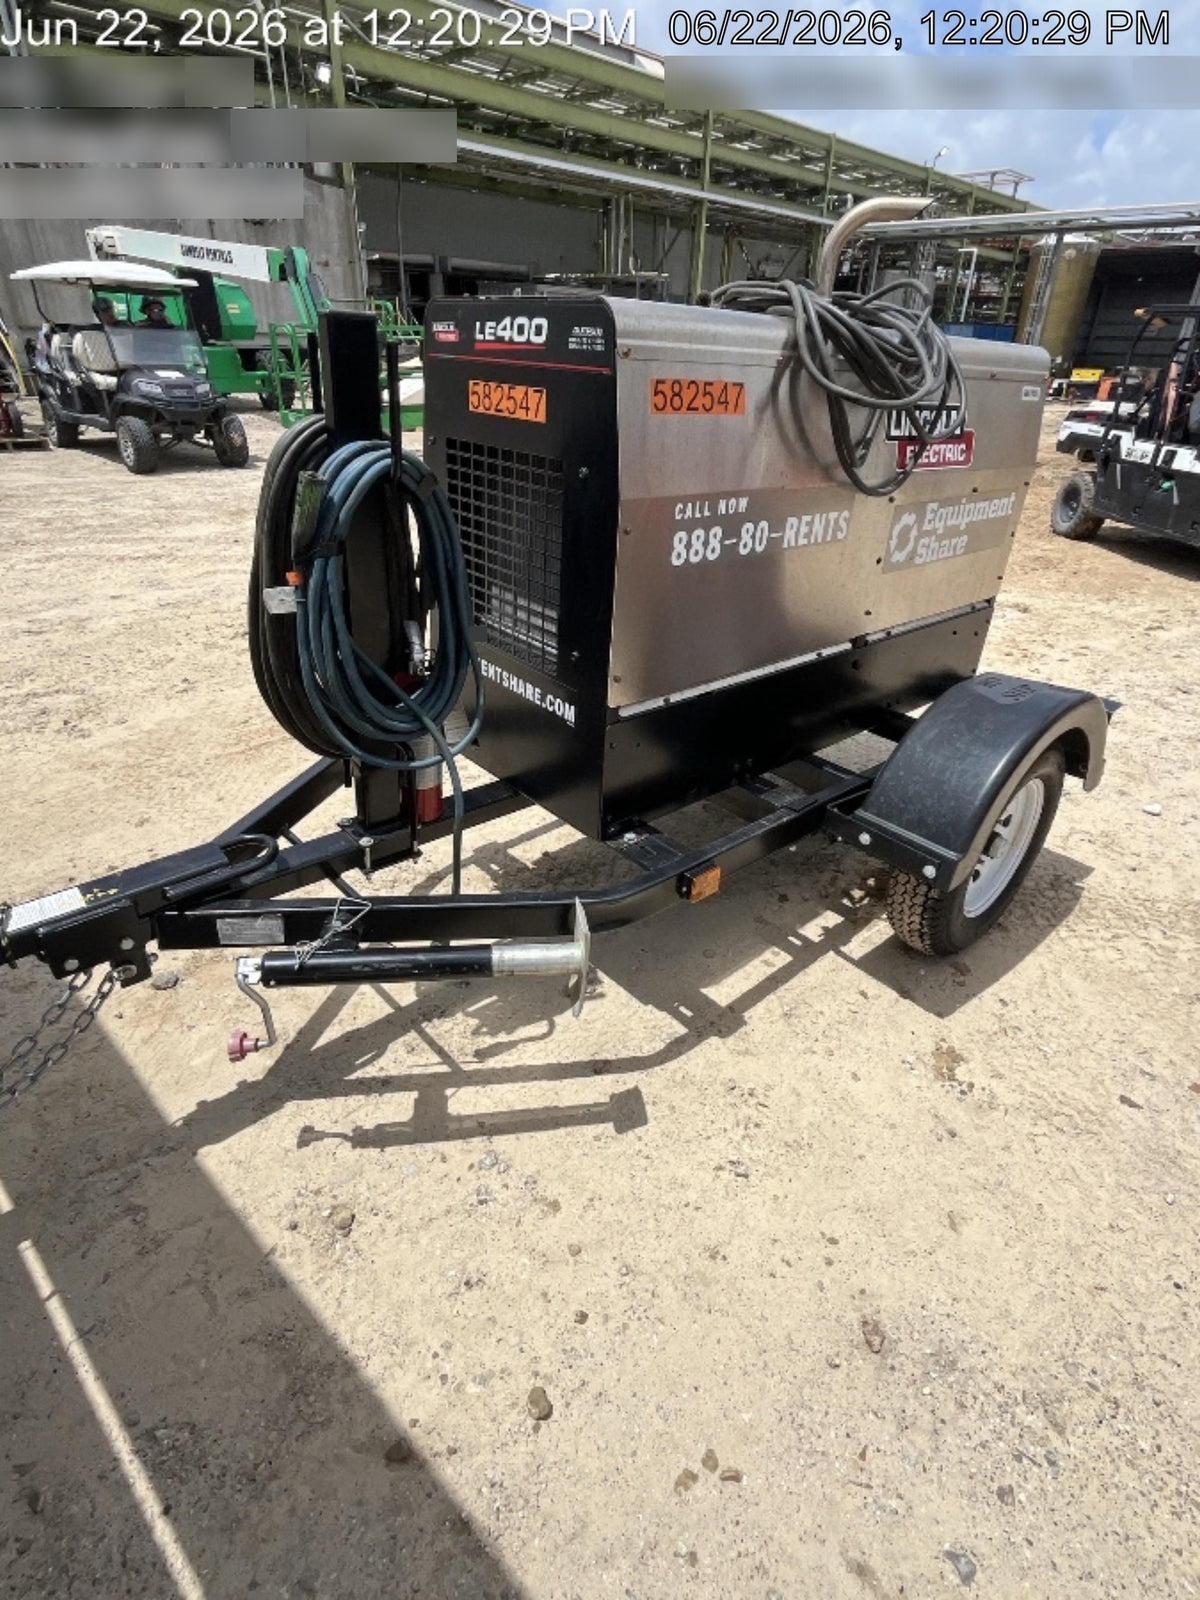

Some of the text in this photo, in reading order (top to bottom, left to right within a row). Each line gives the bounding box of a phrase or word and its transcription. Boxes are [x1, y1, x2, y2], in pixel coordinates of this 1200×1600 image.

[475, 316, 548, 344] LE400
[471, 382, 545, 419] 582547
[653, 380, 744, 412] 582547
[674, 496, 749, 520] CALL NOW
[922, 491, 1016, 534] Equipment
[671, 509, 850, 566] 888-80-RENTS
[914, 534, 968, 565] Share
[477, 657, 576, 723] ENTSHARE.COM
